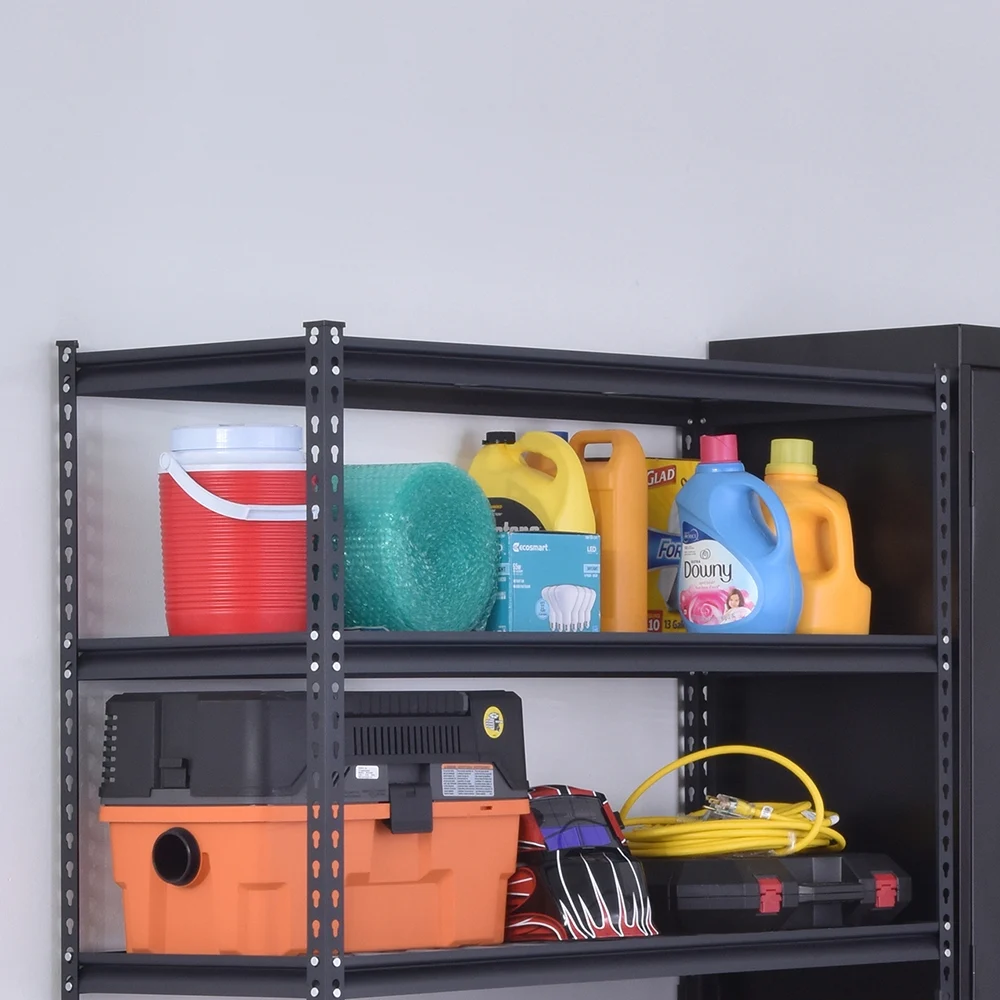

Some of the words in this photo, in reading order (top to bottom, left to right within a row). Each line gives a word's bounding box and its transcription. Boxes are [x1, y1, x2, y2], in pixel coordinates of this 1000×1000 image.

[647, 468, 675, 486] GLAD
[684, 560, 732, 583] Downy
[648, 618, 660, 631] 10
